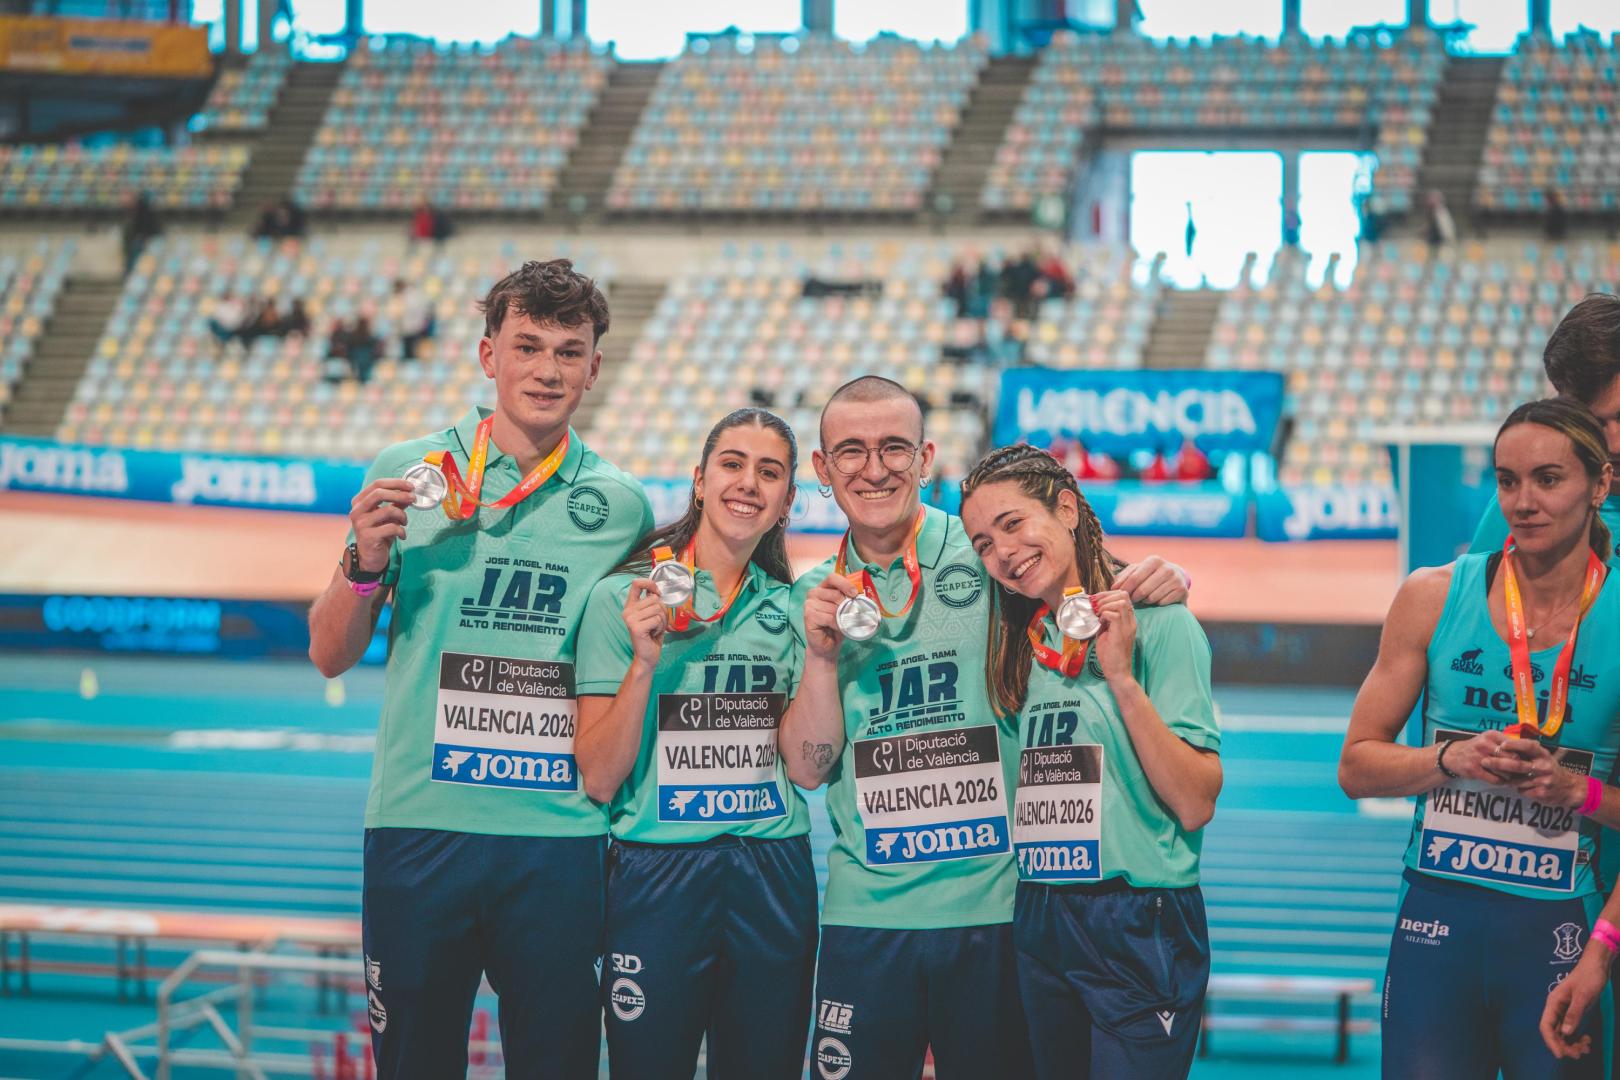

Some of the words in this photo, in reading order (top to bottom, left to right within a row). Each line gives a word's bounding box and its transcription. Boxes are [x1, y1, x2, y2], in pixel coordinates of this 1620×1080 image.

[1017, 386, 1257, 437] VALENCIA
[574, 501, 603, 516] CAPEX
[1284, 483, 1399, 540] Jom
[485, 556, 510, 566] JOSE
[513, 558, 542, 569] ANGEL
[545, 563, 570, 574] RAMA
[460, 567, 568, 624] JAR
[942, 580, 974, 592] CAPEX
[459, 619, 489, 630] ALTO
[492, 621, 566, 637] RENDIMIENTO
[703, 654, 725, 662] JOSE
[727, 654, 751, 662] ANGEL
[876, 660, 899, 673] JOSE
[901, 654, 929, 666] ANGEL
[932, 649, 958, 660] RAMA
[498, 661, 560, 679] Diputació
[496, 680, 514, 693] de
[516, 681, 567, 697] València
[869, 661, 959, 726] JAR
[715, 697, 768, 712] Diputació
[1063, 700, 1081, 708] RAMA
[443, 703, 535, 736] VALENCIA
[538, 712, 574, 738] 2026
[715, 715, 731, 728] de
[732, 715, 775, 728] València
[866, 724, 893, 736] ALTO
[896, 712, 966, 731] RENDIMIENTO
[905, 732, 967, 753] Diputació
[665, 744, 753, 770] VALENCIA
[755, 743, 775, 769] 2026
[907, 756, 924, 769] de
[925, 750, 980, 768] València
[1034, 750, 1073, 768] Diputació
[470, 753, 572, 783] Joma
[1033, 771, 1045, 783] de
[1045, 768, 1081, 783] València
[699, 787, 776, 818] Joma
[864, 782, 954, 815] VALENCIA
[954, 777, 998, 805] 2026
[1016, 799, 1058, 827] VALENCIA
[1060, 798, 1094, 824] 2026
[1431, 787, 1524, 826] VALENCIA
[1527, 801, 1574, 831] 2026
[902, 823, 1000, 859] Joma
[1451, 838, 1563, 881] Joma
[1400, 918, 1450, 938] nerja
